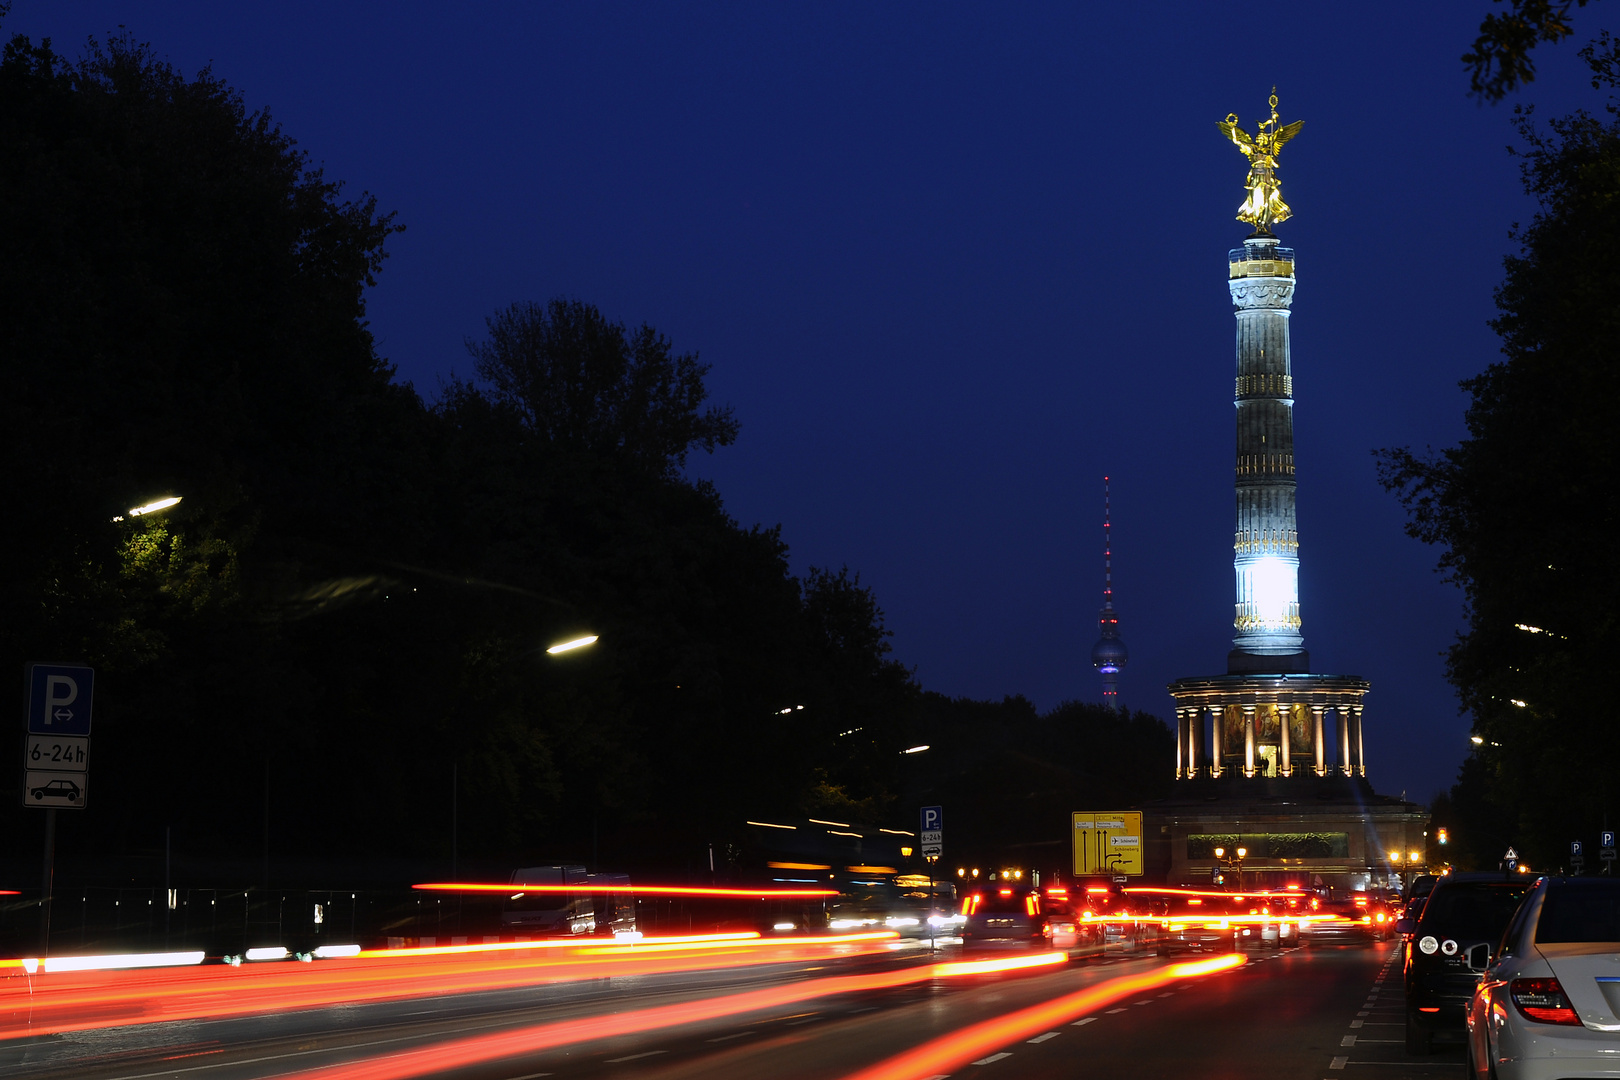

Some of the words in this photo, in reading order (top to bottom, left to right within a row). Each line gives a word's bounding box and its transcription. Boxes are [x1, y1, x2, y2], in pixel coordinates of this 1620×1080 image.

[44, 674, 78, 725] P
[926, 810, 937, 829] P
[1605, 833, 1611, 845] P
[1573, 843, 1580, 854] P
